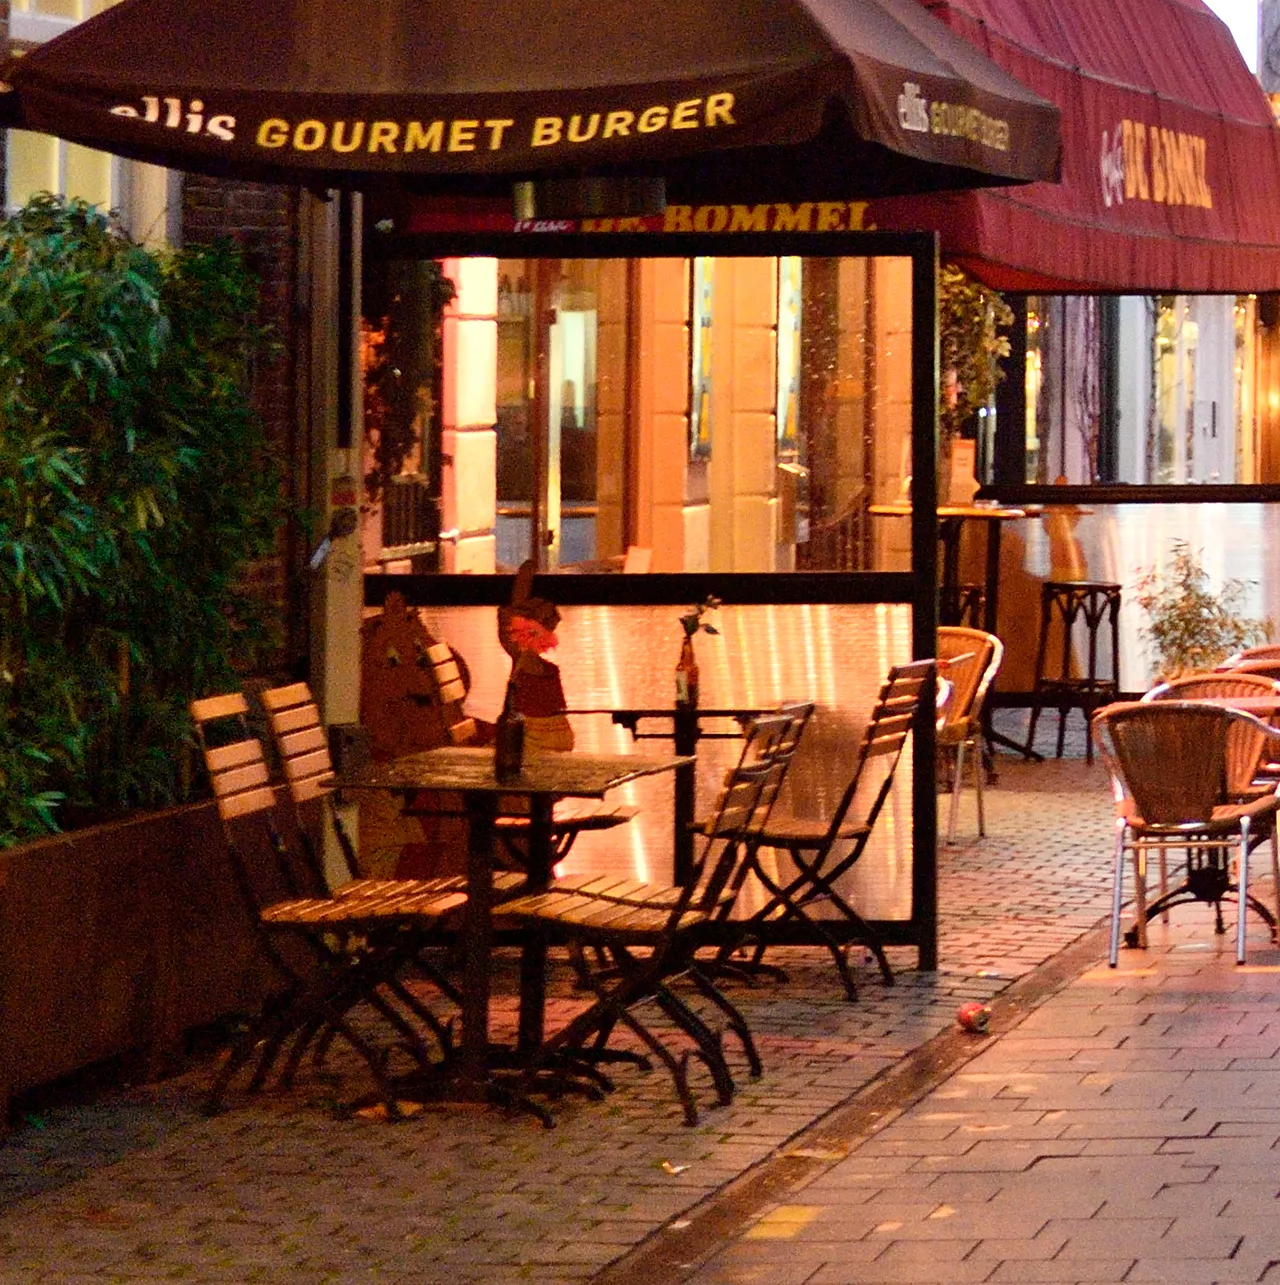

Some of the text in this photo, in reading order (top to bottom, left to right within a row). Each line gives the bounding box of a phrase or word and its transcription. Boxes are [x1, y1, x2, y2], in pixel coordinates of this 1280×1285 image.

[256, 117, 514, 154] GOURMET
[530, 91, 736, 149] BURGER
[661, 200, 878, 233] BOMMEL
